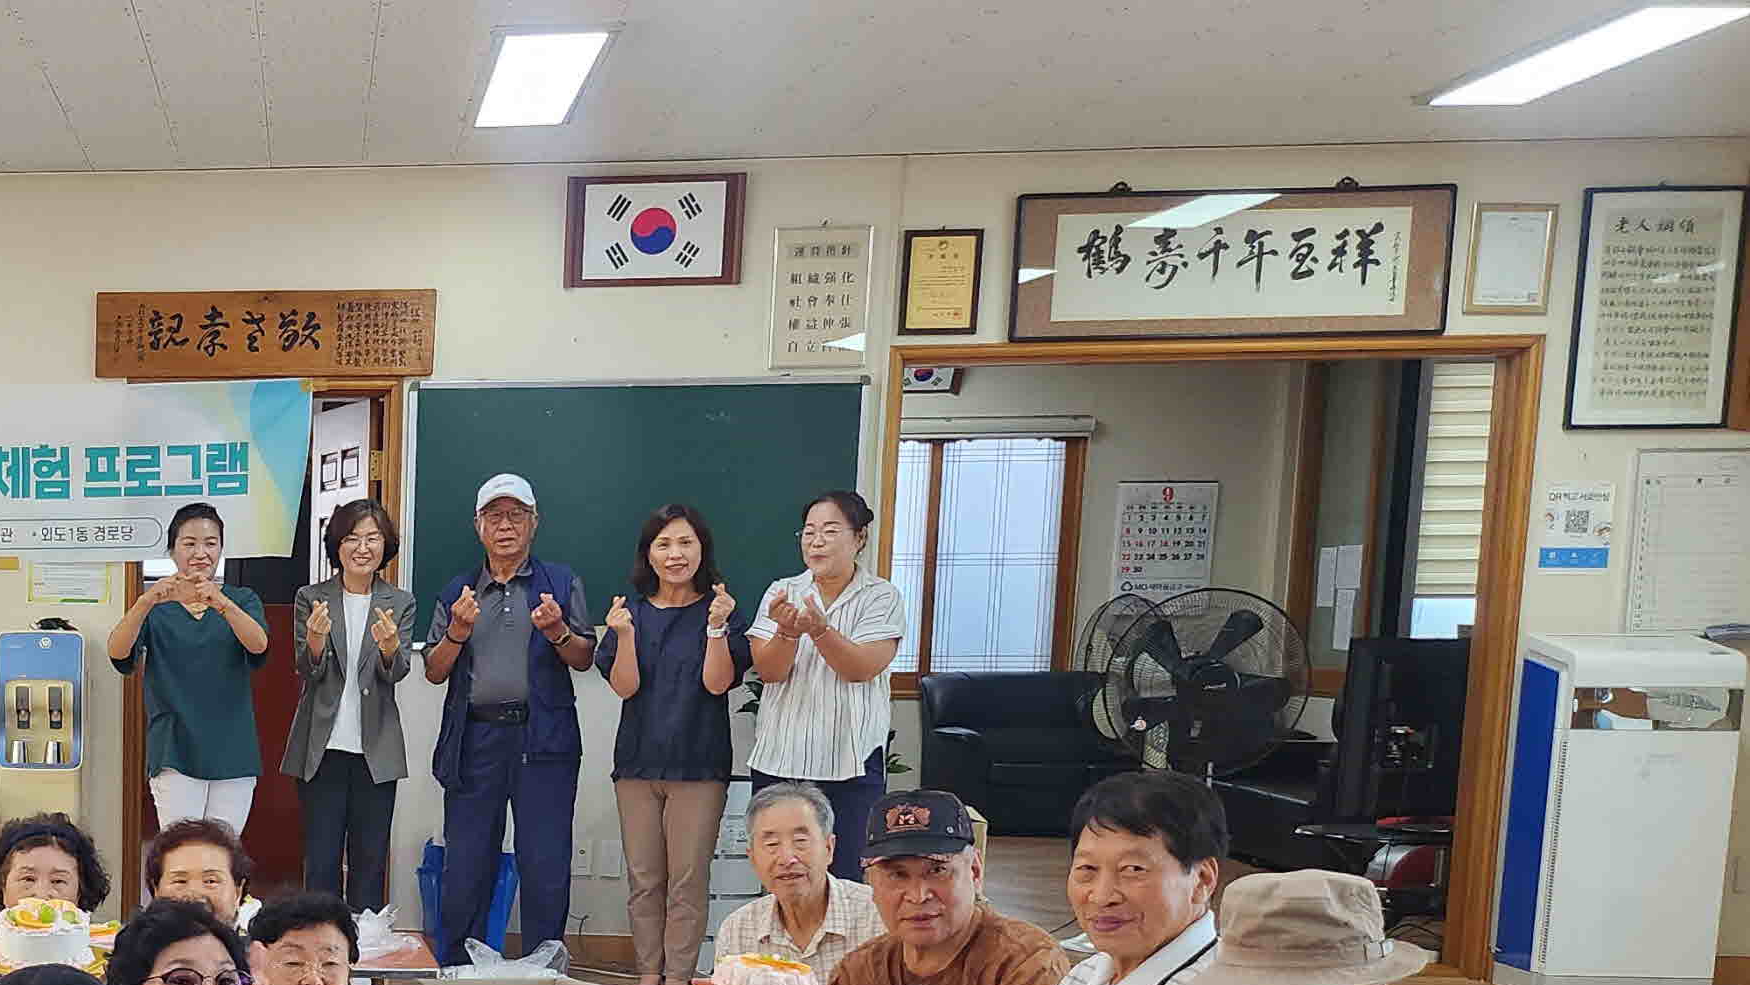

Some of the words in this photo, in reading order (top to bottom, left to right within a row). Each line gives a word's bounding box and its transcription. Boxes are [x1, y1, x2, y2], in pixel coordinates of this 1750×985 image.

[83, 441, 250, 498] 프로그램
[1162, 487, 1174, 504] 9
[40, 527, 88, 543] 외도1동
[93, 525, 134, 542] 경로당
